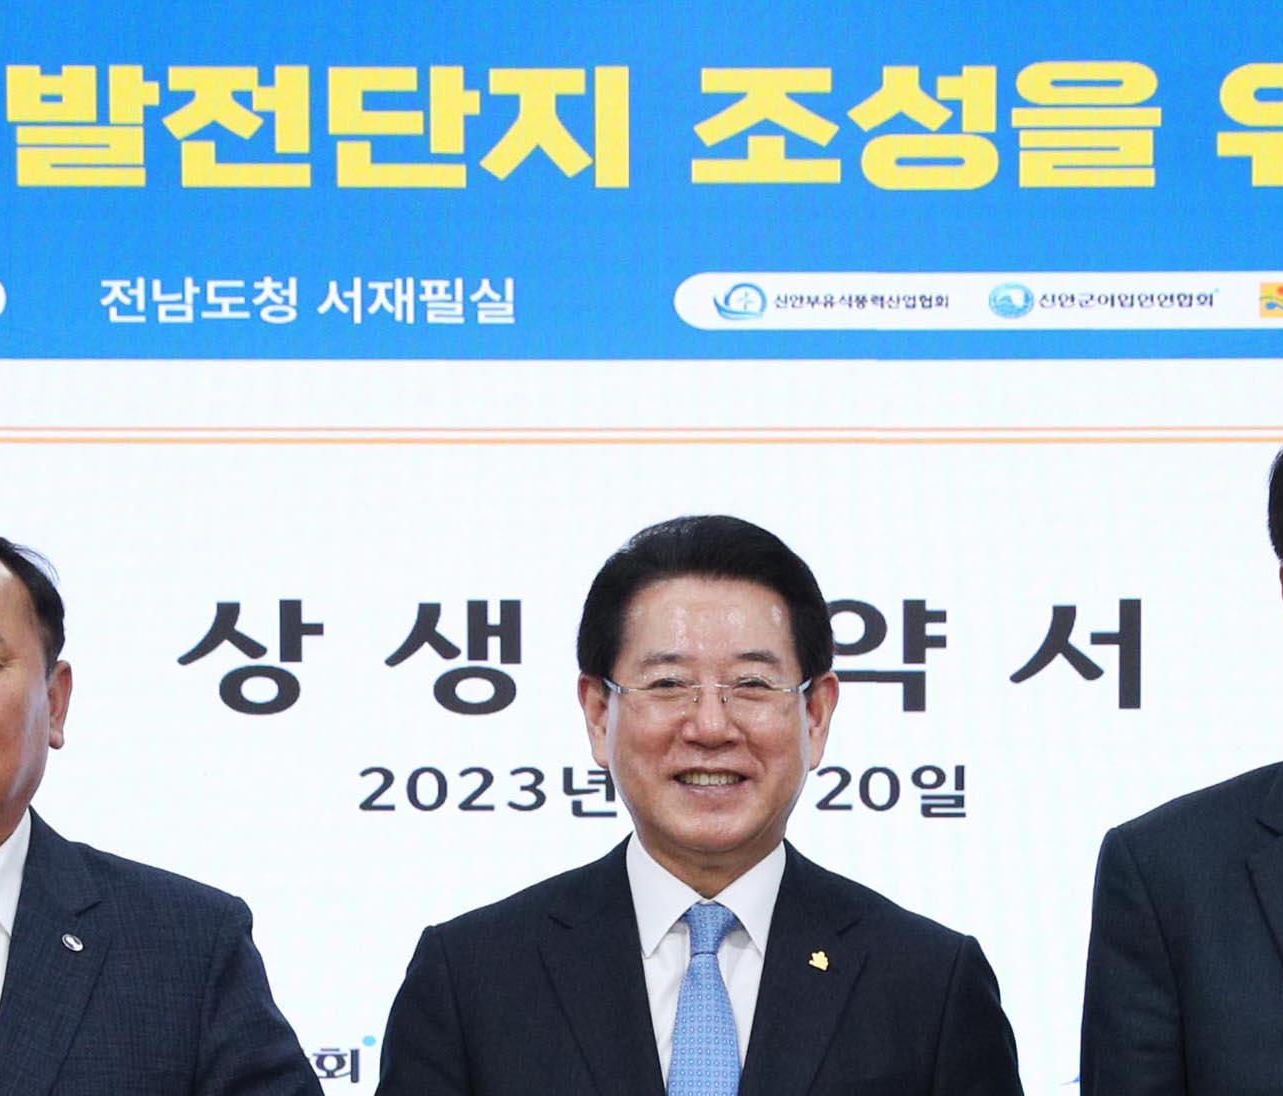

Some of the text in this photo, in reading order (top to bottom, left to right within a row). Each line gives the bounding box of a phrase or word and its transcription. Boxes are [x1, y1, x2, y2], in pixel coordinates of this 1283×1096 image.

[5, 64, 630, 189] 발전단지
[690, 60, 1162, 191] 조성을
[100, 275, 515, 324] 전남도청 서재필실
[359, 764, 967, 818] 2023년 20일
